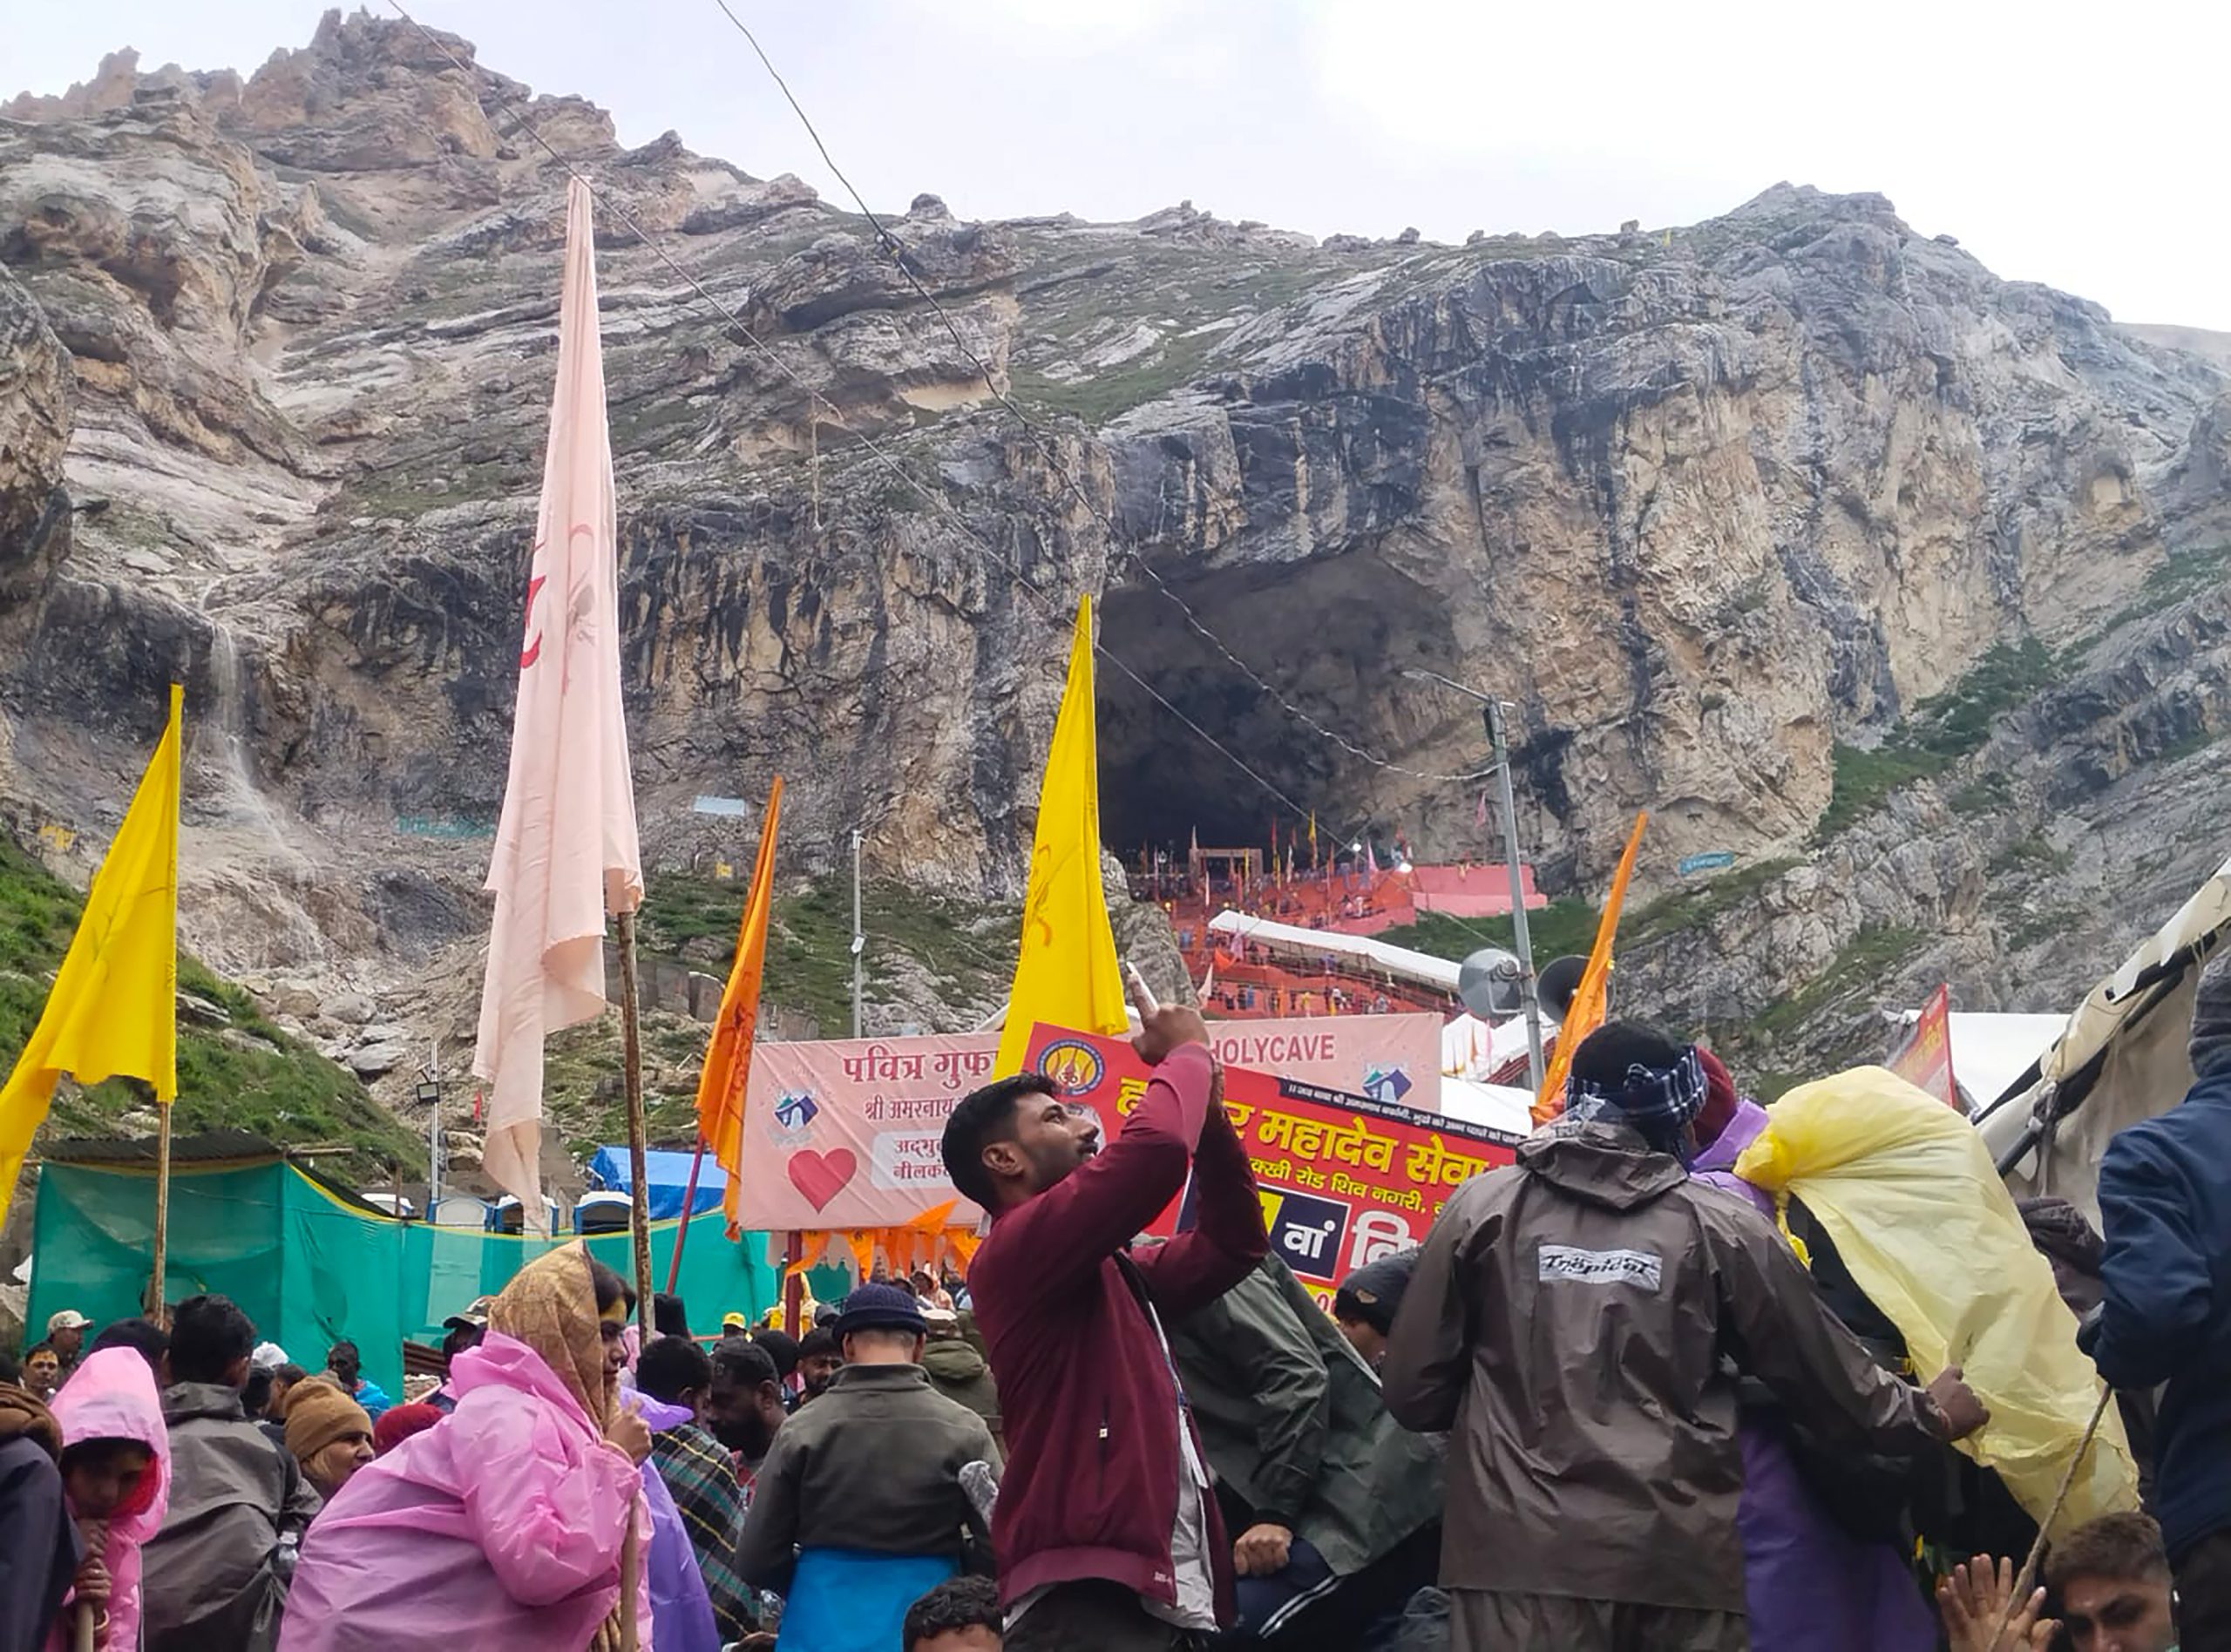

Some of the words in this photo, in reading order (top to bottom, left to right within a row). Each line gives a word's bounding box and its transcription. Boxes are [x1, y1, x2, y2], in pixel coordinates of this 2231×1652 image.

[843, 1045, 926, 1083] पवित्र
[1211, 1034, 1335, 1065] HOLYCAVE
[865, 1094, 884, 1121] श्री
[1258, 1109, 1398, 1174] महादेव
[1296, 1165, 1327, 1190] रोड
[1332, 1173, 1367, 1198] शिव
